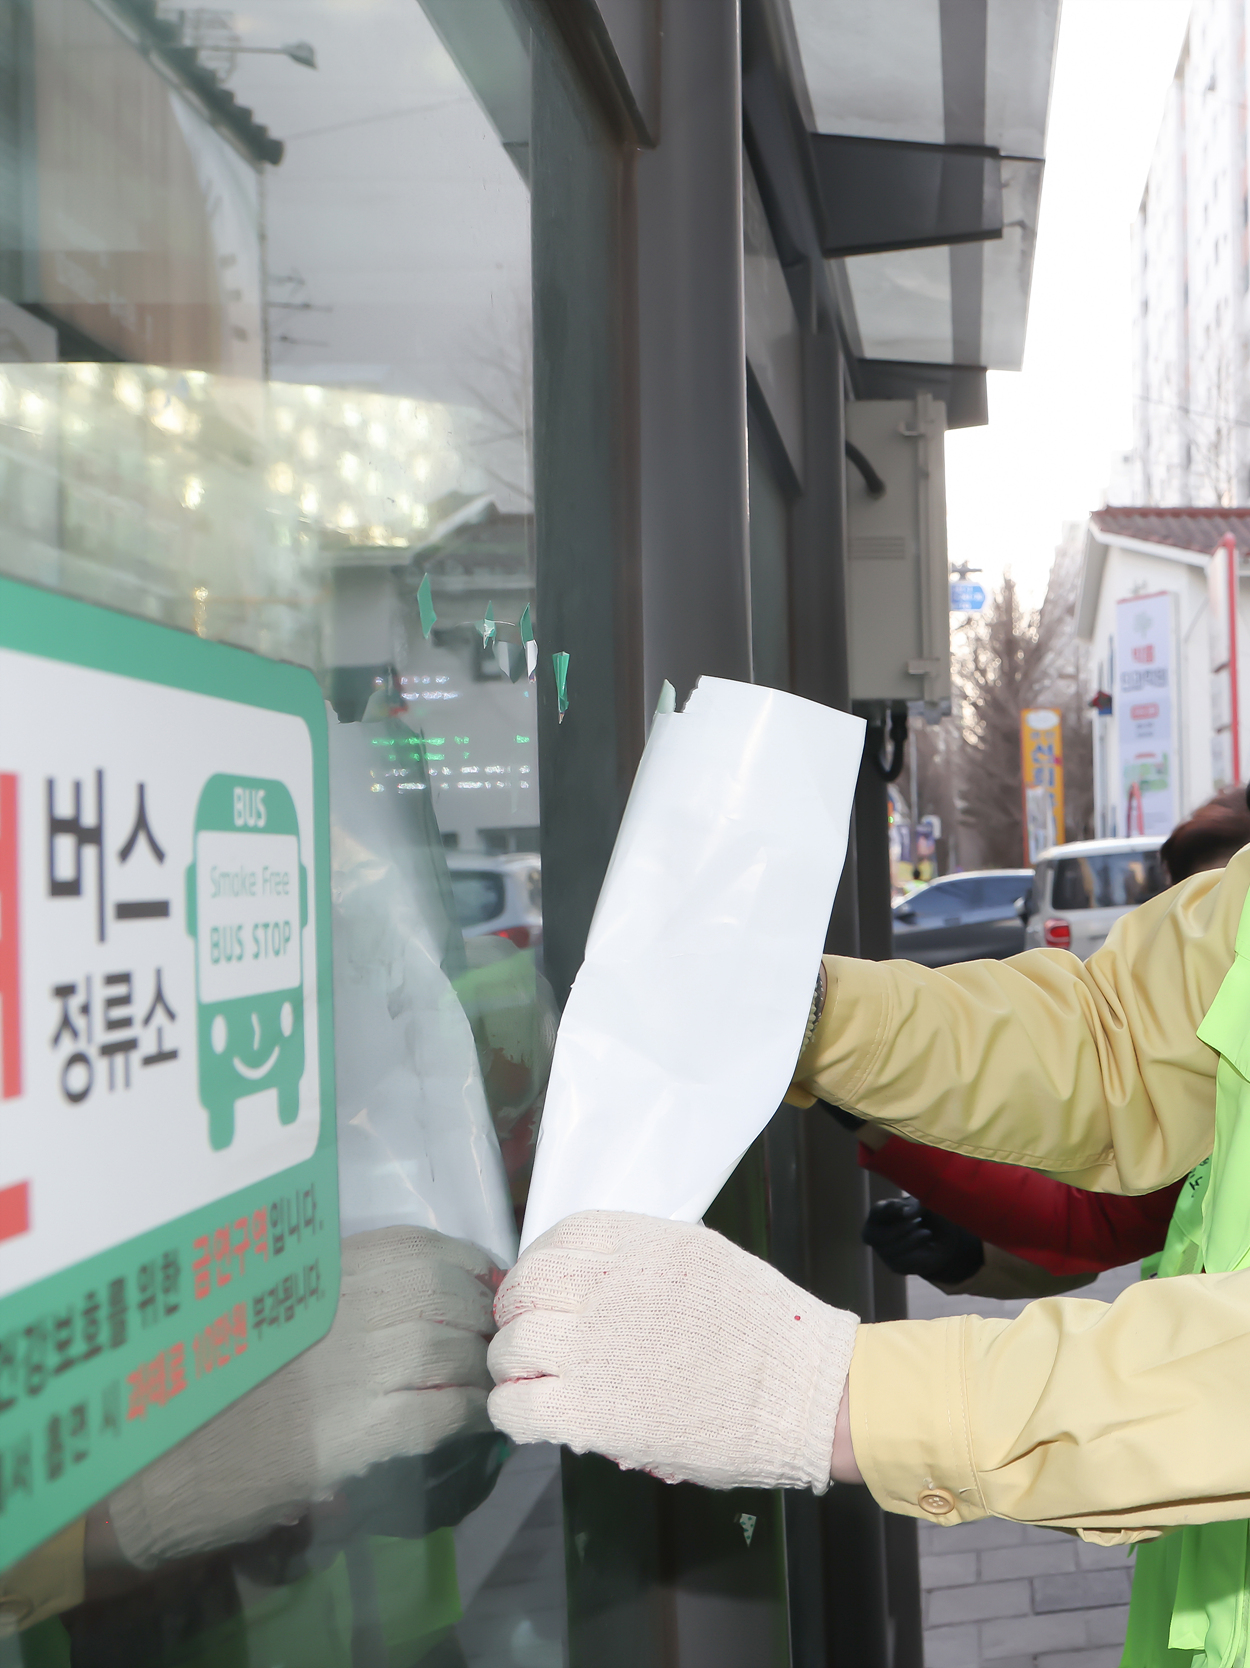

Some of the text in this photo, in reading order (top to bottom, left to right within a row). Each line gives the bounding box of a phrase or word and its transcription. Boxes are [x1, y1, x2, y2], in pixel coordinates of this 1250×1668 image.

[233, 786, 267, 828] BUS
[45, 767, 171, 944] 버스
[209, 864, 291, 899] Smoke Free
[209, 920, 292, 965] BUS STOP
[50, 966, 179, 1103] 정류소
